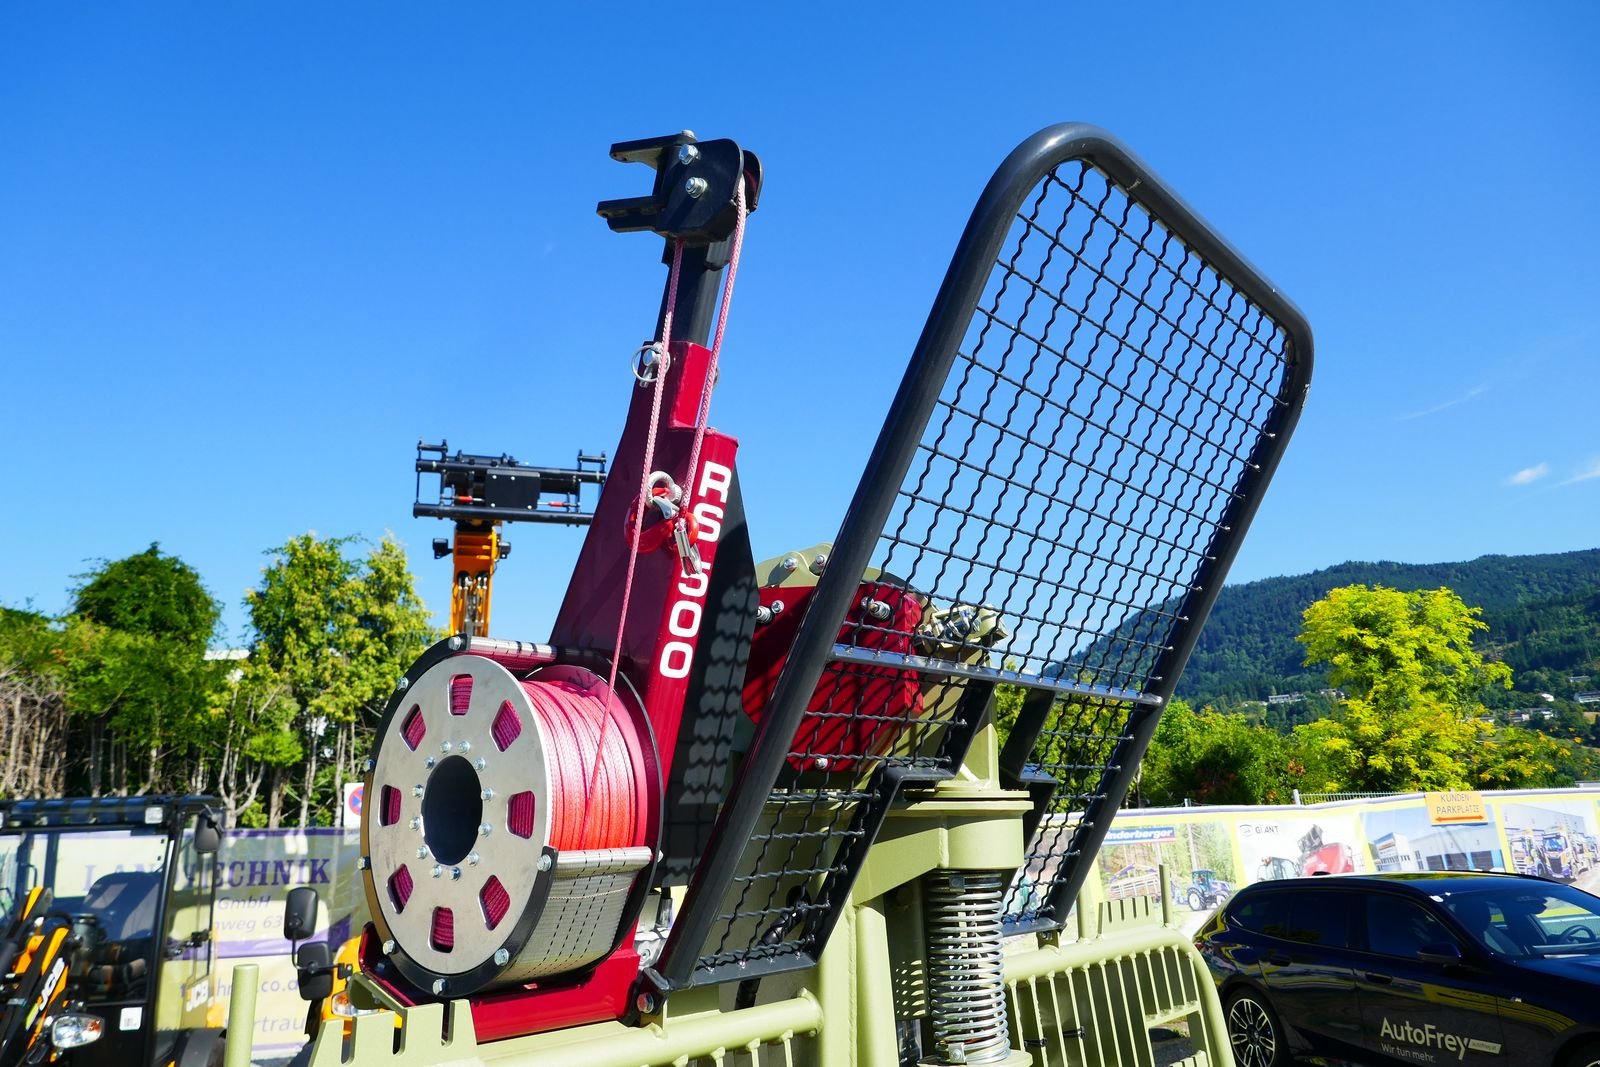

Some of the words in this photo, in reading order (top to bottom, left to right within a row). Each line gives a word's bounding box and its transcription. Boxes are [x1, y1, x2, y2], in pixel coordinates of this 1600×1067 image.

[693, 461, 732, 543] RS
[659, 561, 712, 679] 500
[1105, 829, 1174, 840] inderberger
[218, 895, 271, 910] GmbH
[1380, 1016, 1469, 1061] AutoFrey
[1381, 1043, 1395, 1054] Wir
[1396, 1046, 1411, 1057] tun
[1412, 1051, 1437, 1063] mehr.
